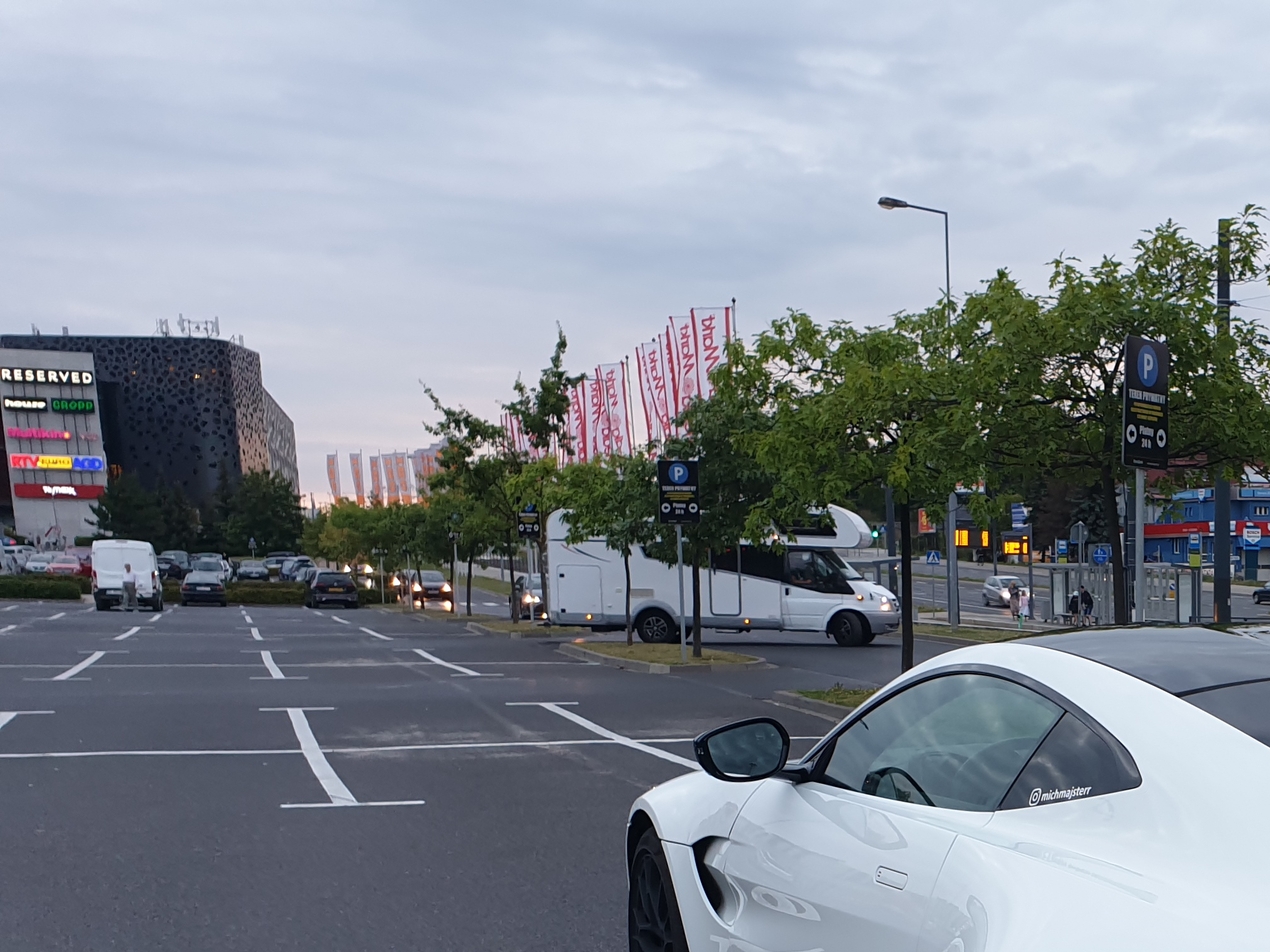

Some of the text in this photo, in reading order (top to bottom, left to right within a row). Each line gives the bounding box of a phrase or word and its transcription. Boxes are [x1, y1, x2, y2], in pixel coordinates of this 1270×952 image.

[1143, 353, 1154, 380] P
[1, 368, 93, 384] RESERVED
[11, 454, 39, 468] RTV
[674, 466, 684, 481] P
